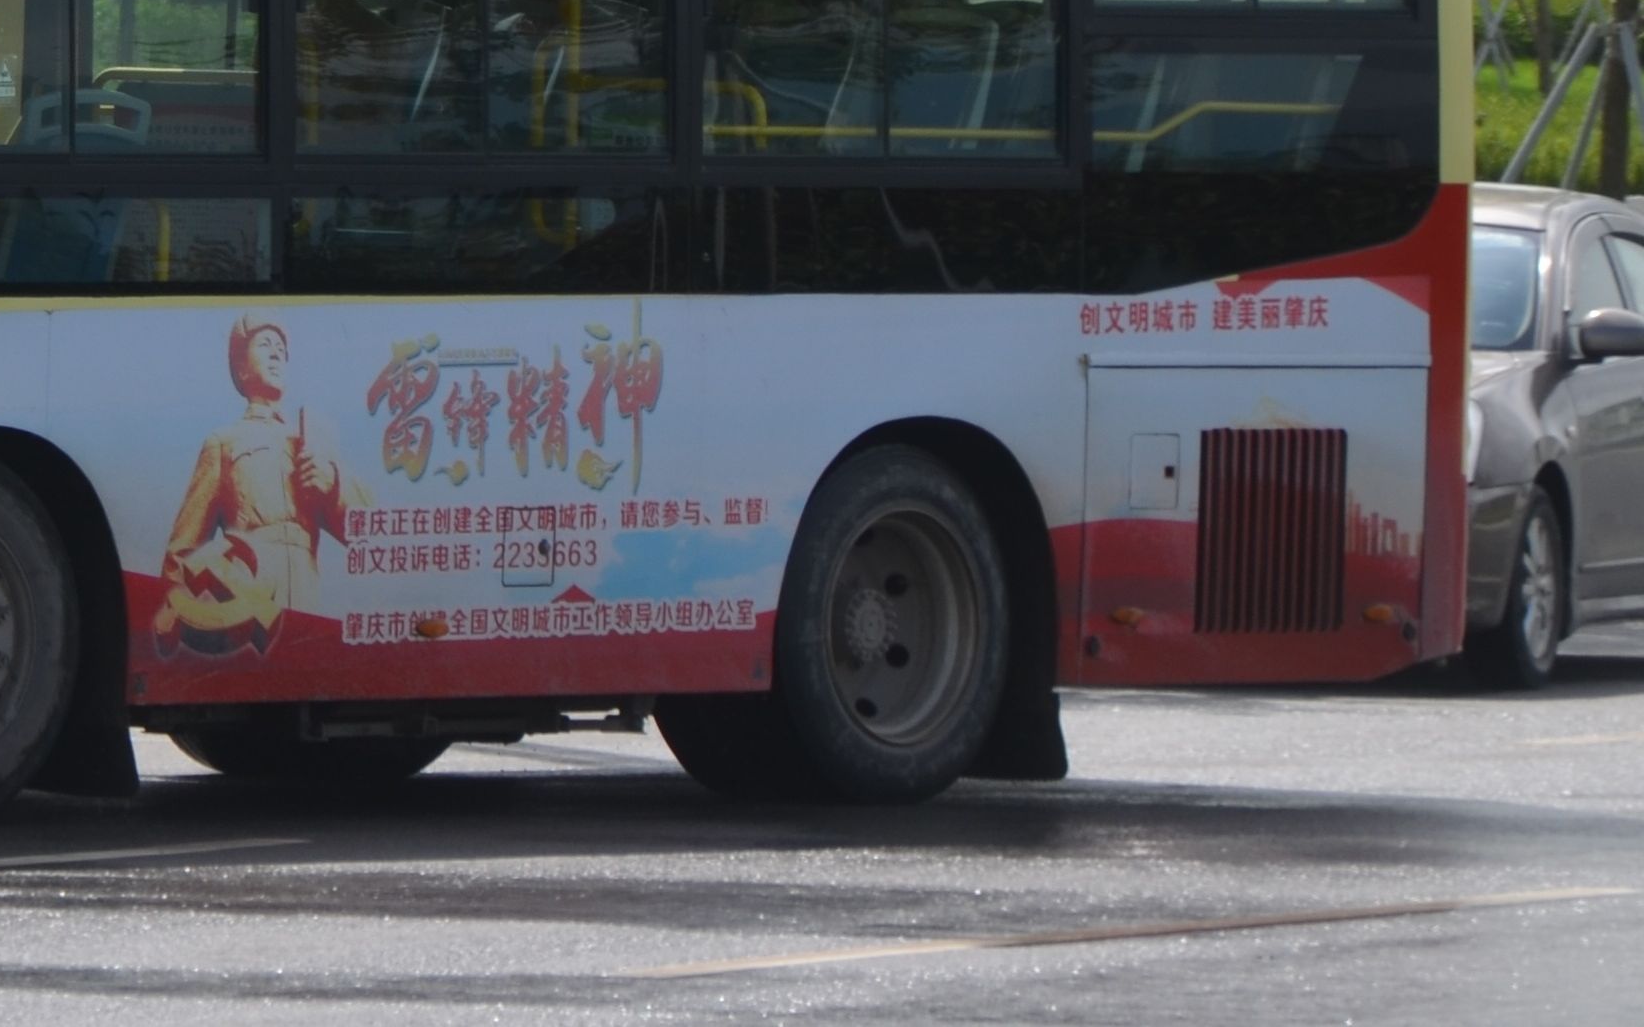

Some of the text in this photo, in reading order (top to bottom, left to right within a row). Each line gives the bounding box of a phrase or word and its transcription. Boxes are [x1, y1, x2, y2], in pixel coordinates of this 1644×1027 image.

[1079, 296, 1330, 335] 创文明城市 建美丽肇庆
[367, 298, 663, 494] 雷锋精神
